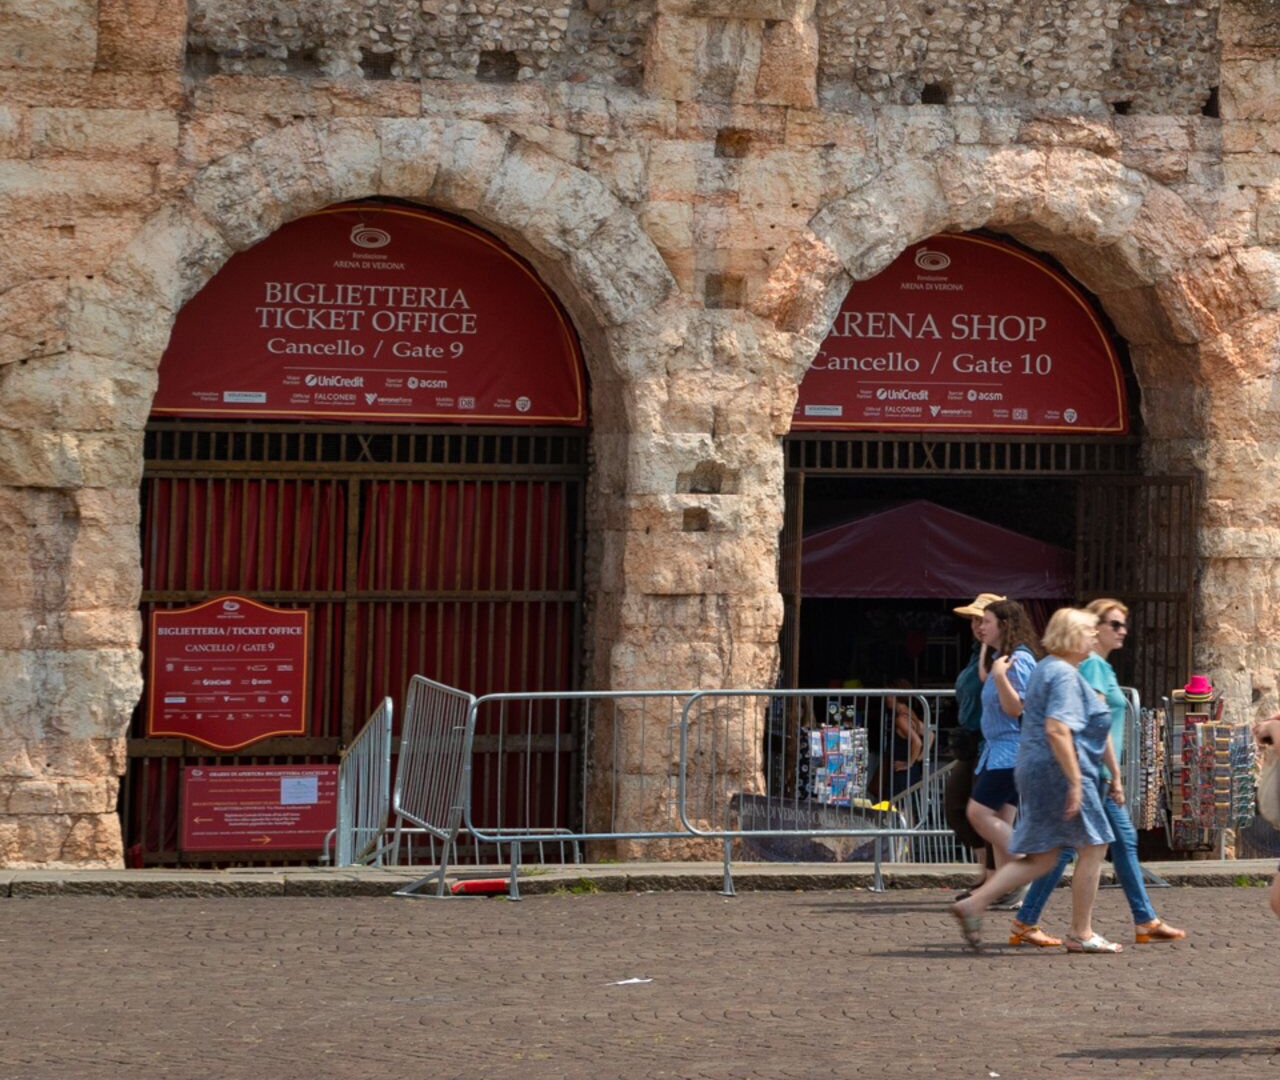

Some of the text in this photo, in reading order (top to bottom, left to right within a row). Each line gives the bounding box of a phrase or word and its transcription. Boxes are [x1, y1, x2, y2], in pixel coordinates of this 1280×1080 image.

[333, 261, 405, 270] ARENA DI VERONA
[901, 282, 964, 291] ARENA DI VERONA
[265, 282, 470, 309] BIGLIETTERIA
[256, 308, 477, 334] TICKET OFFICE
[951, 314, 1047, 342] SHOP
[267, 338, 464, 358] Cancello / Gate 9
[810, 351, 1052, 375] Cancello / Gate 10
[318, 376, 364, 387] UniCredit
[314, 393, 356, 401] FALCONERI
[888, 389, 929, 401] UniCredit
[885, 406, 922, 414] FALCONERI
[158, 627, 303, 636] BIGLIETTERIA / TICKET OFFICE
[185, 642, 275, 652] CANCELLO / GATE 9
